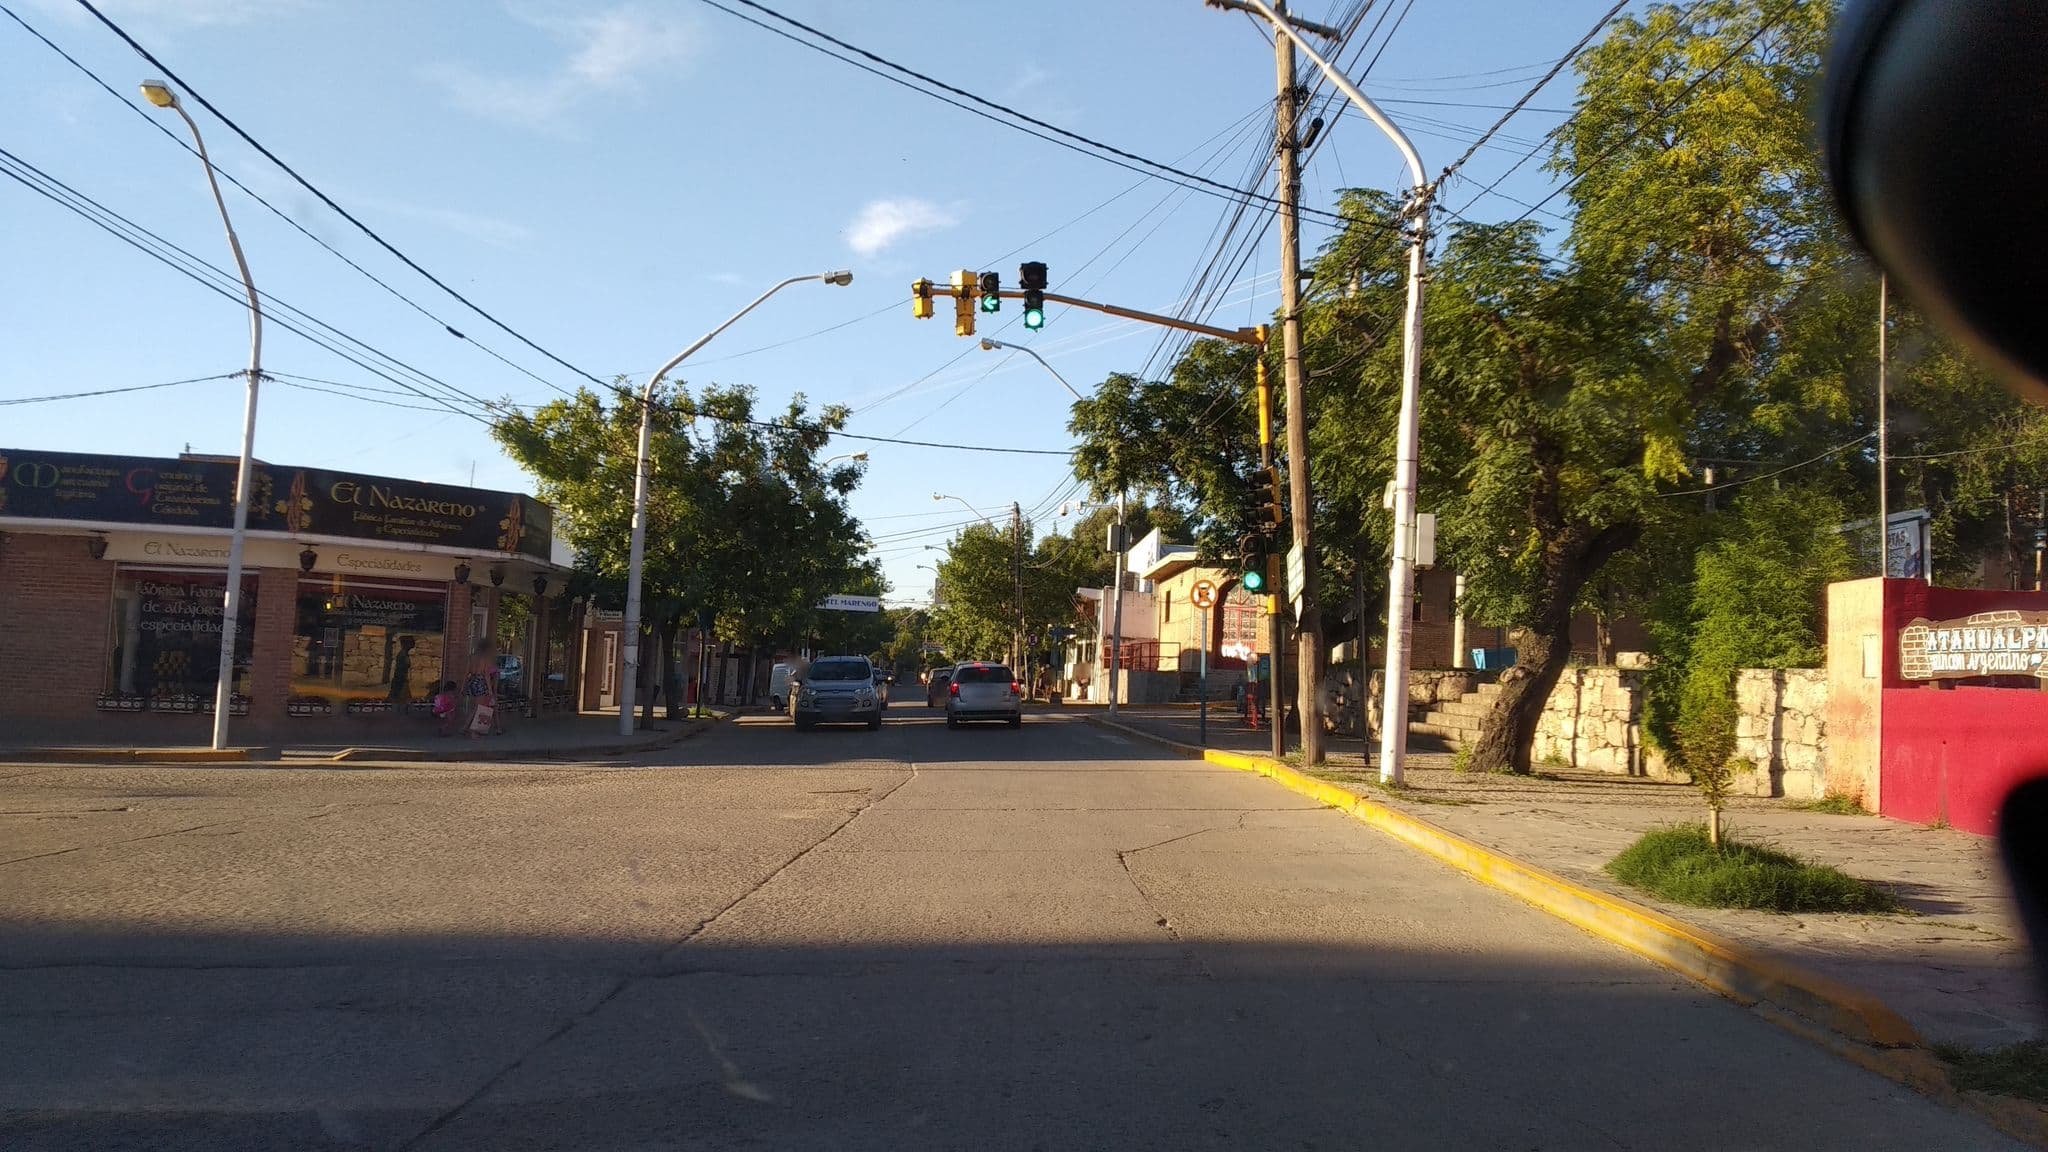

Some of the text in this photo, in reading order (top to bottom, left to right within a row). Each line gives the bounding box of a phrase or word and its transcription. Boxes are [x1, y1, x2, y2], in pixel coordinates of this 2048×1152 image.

[330, 482, 475, 518] El Nazareno
[144, 541, 161, 555] El
[337, 553, 423, 573] Especialidades
[142, 600, 160, 613] de
[352, 594, 416, 610] Nazareno
[840, 599, 877, 608] MARENGO
